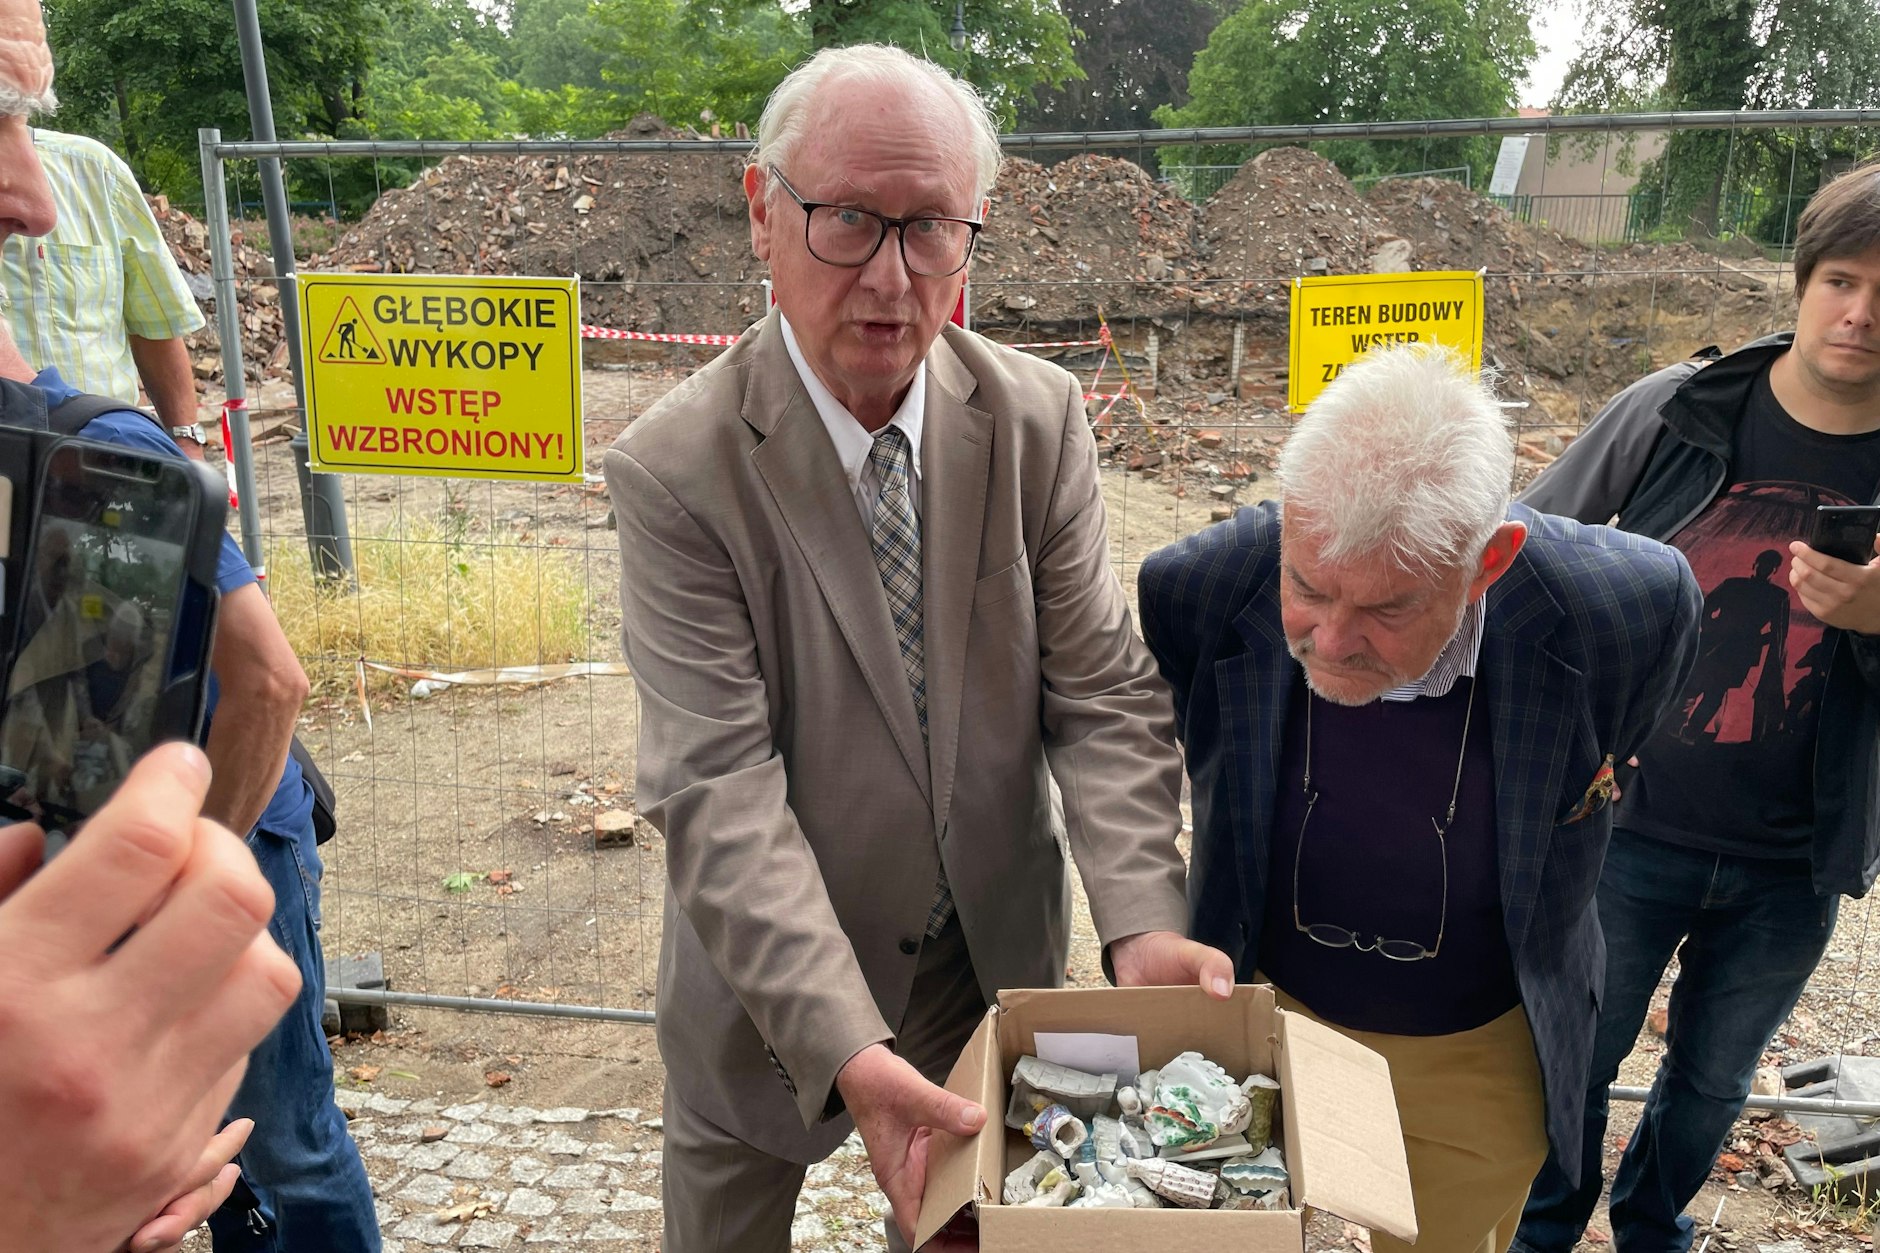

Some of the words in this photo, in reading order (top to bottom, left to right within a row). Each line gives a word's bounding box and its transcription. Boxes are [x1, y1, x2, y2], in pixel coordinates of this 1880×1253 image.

[373, 295, 556, 332] GŁĘBOKIE
[1310, 304, 1371, 327] TEREN
[1378, 300, 1464, 324] BUDOWY
[387, 338, 544, 371] WYKOPY
[385, 387, 502, 424] WSTĘP
[327, 424, 564, 460] WZBRONIONY!
